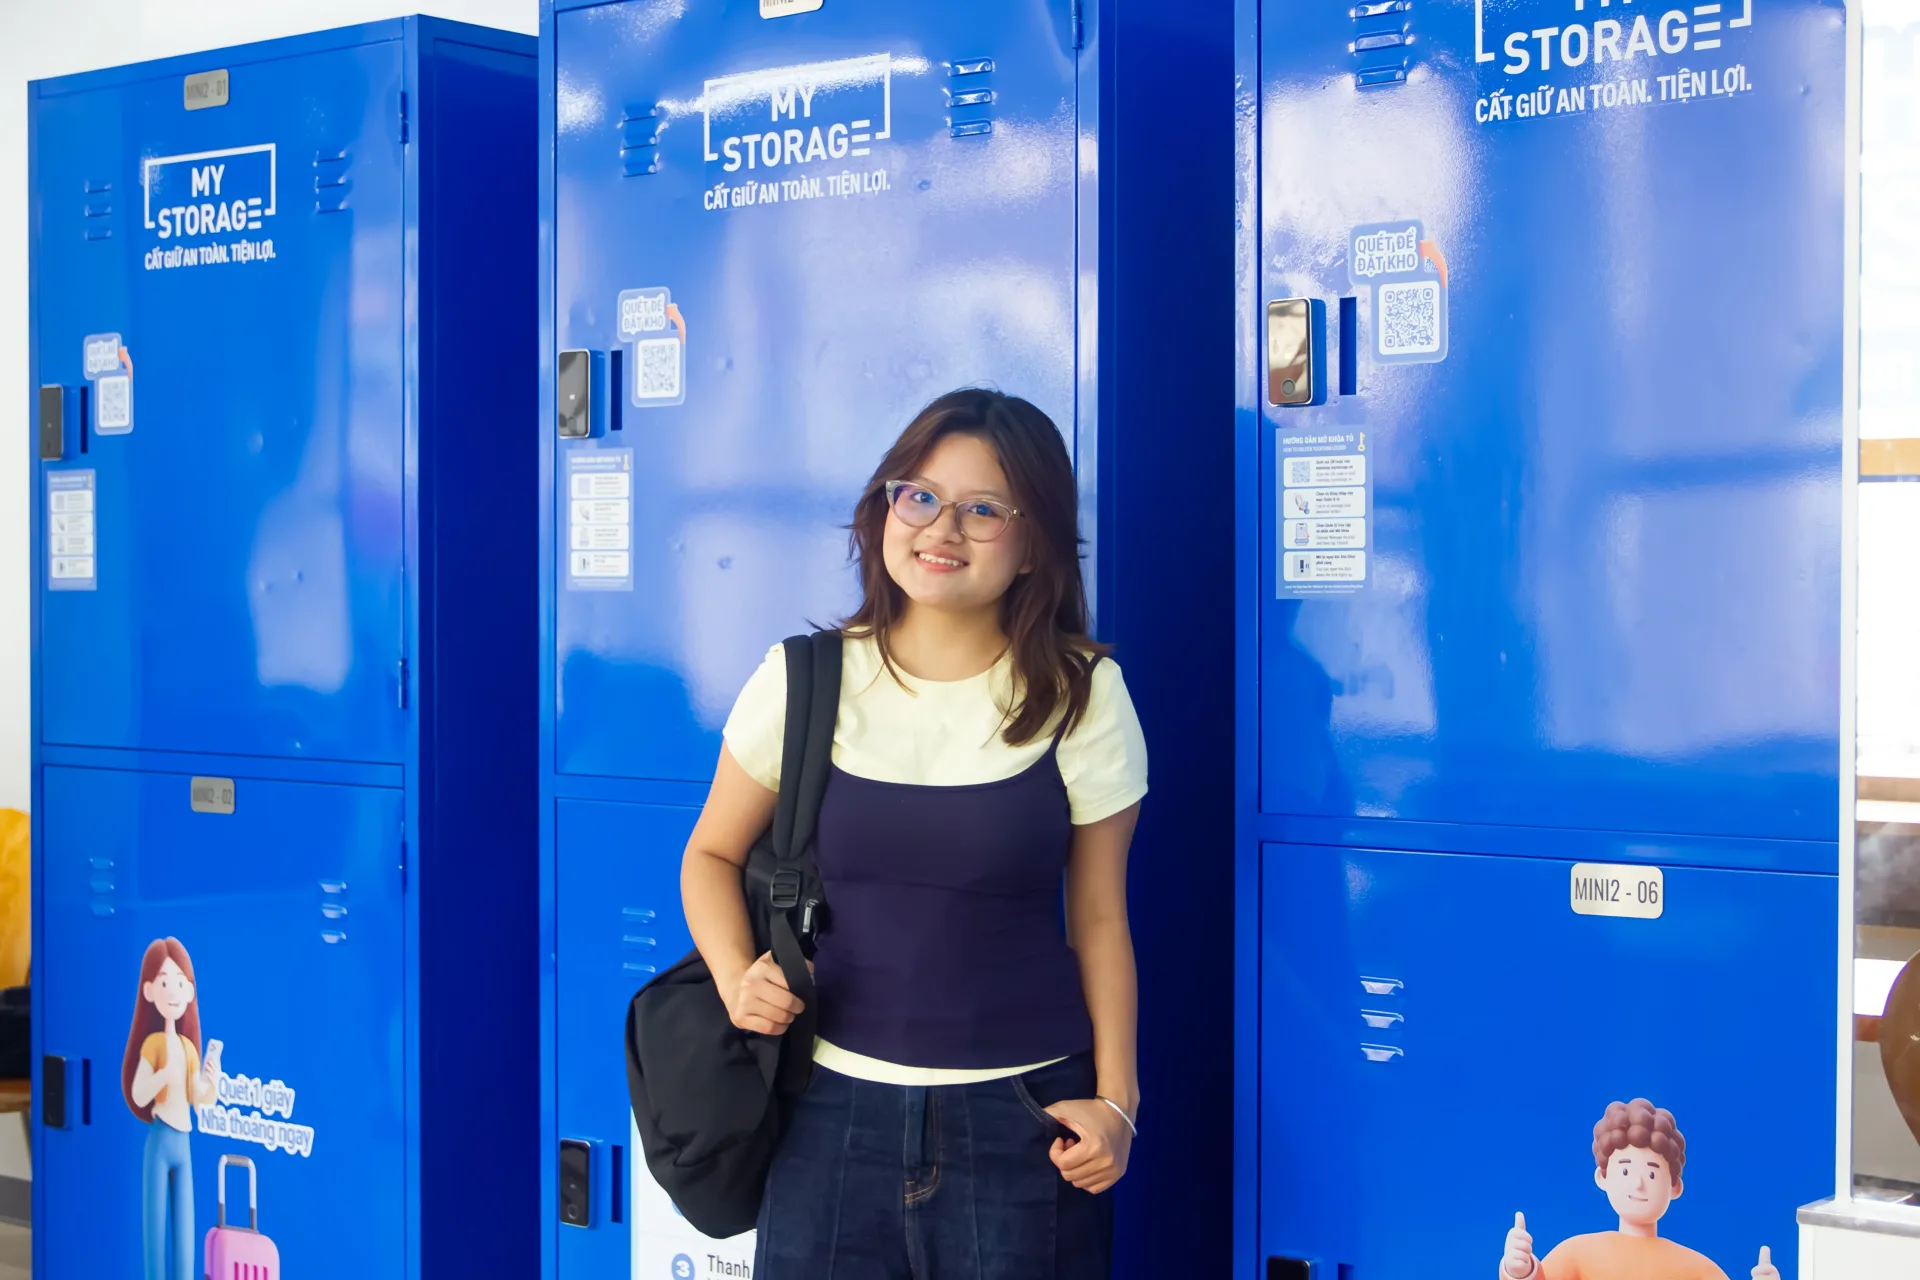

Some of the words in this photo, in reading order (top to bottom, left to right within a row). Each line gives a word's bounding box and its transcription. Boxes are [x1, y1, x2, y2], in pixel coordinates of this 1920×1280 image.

[1503, 3, 1721, 75] STORAGE
[216, 78, 226, 96] 01
[771, 81, 816, 122] MY
[1475, 88, 1513, 123] CẤT
[1516, 85, 1553, 117] GIỮ
[1555, 87, 1585, 114] AN
[1589, 75, 1652, 109] TOÀN.
[1656, 67, 1707, 104] TIỆN
[1711, 63, 1752, 98] LỢI.
[722, 119, 871, 172] STORAGE
[191, 164, 225, 198] MY
[704, 182, 730, 210] CẤT
[731, 180, 757, 208] GIỮ
[759, 183, 778, 204] AN
[781, 174, 824, 201] TOÀN.
[827, 169, 861, 200] TIỆN
[863, 168, 891, 195] LỢI.
[157, 197, 262, 239] STORAGE
[144, 246, 163, 270] CẤT
[164, 244, 183, 268] GIỮ
[183, 247, 198, 267] AN
[199, 241, 230, 265] TOÀN.
[230, 238, 254, 265] TIỆN
[256, 239, 276, 262] LỢI.
[1357, 233, 1392, 254] QUÉT
[1387, 254, 1416, 269] KHO
[1575, 877, 1620, 902] MINI2
[1638, 880, 1658, 904] 06
[218, 1076, 250, 1104] Quét
[201, 1108, 227, 1132] Nhà
[230, 1112, 275, 1147] thoáng
[279, 1126, 311, 1153] ngay
[675, 1260, 690, 1278] 3
[707, 1254, 751, 1280] Thanh
